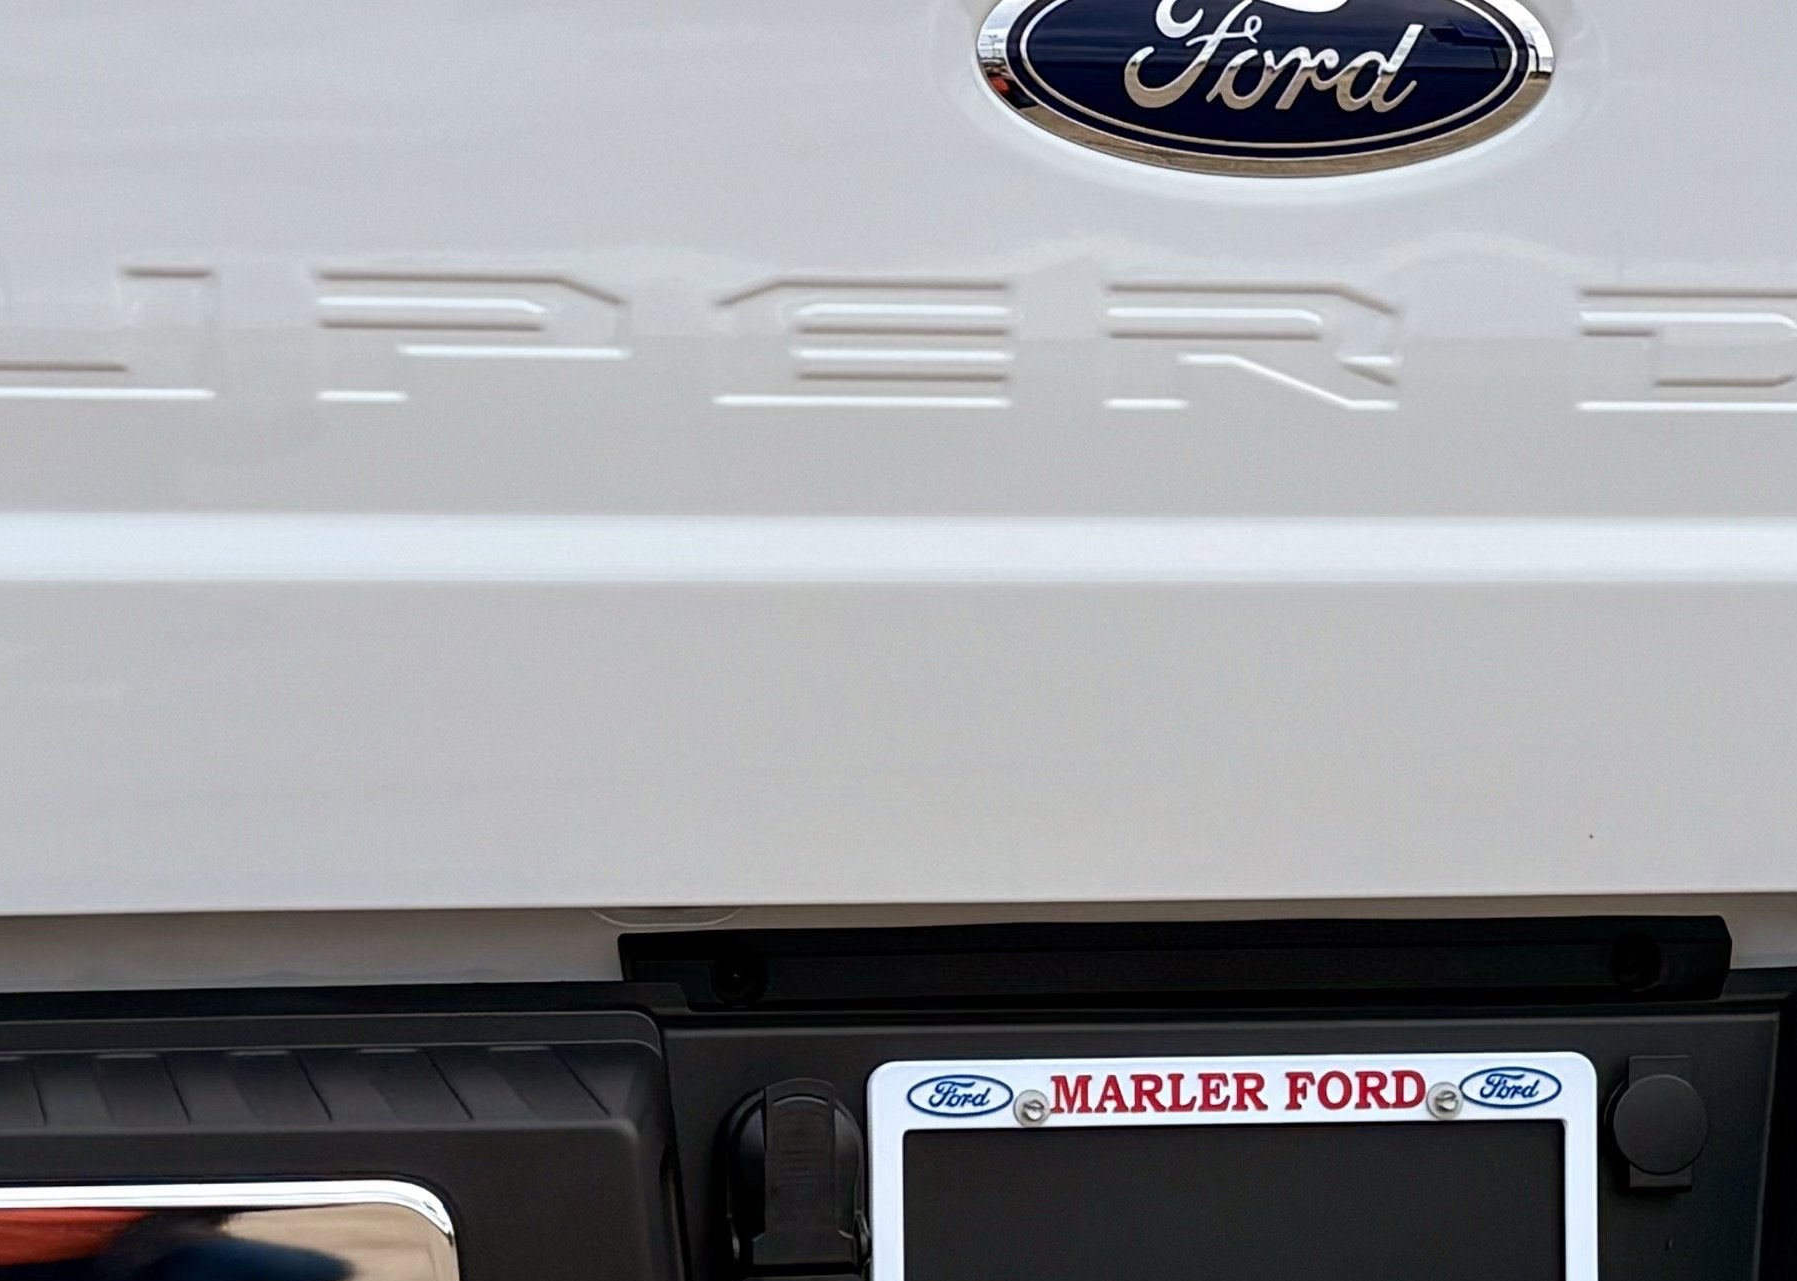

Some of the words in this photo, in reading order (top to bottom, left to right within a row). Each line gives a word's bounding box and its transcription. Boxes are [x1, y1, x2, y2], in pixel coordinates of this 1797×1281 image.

[929, 1081, 991, 1107] Ford
[1050, 1073, 1268, 1113] MARLER
[1284, 1070, 1426, 1110] FORD
[1480, 1073, 1540, 1099] Ford
